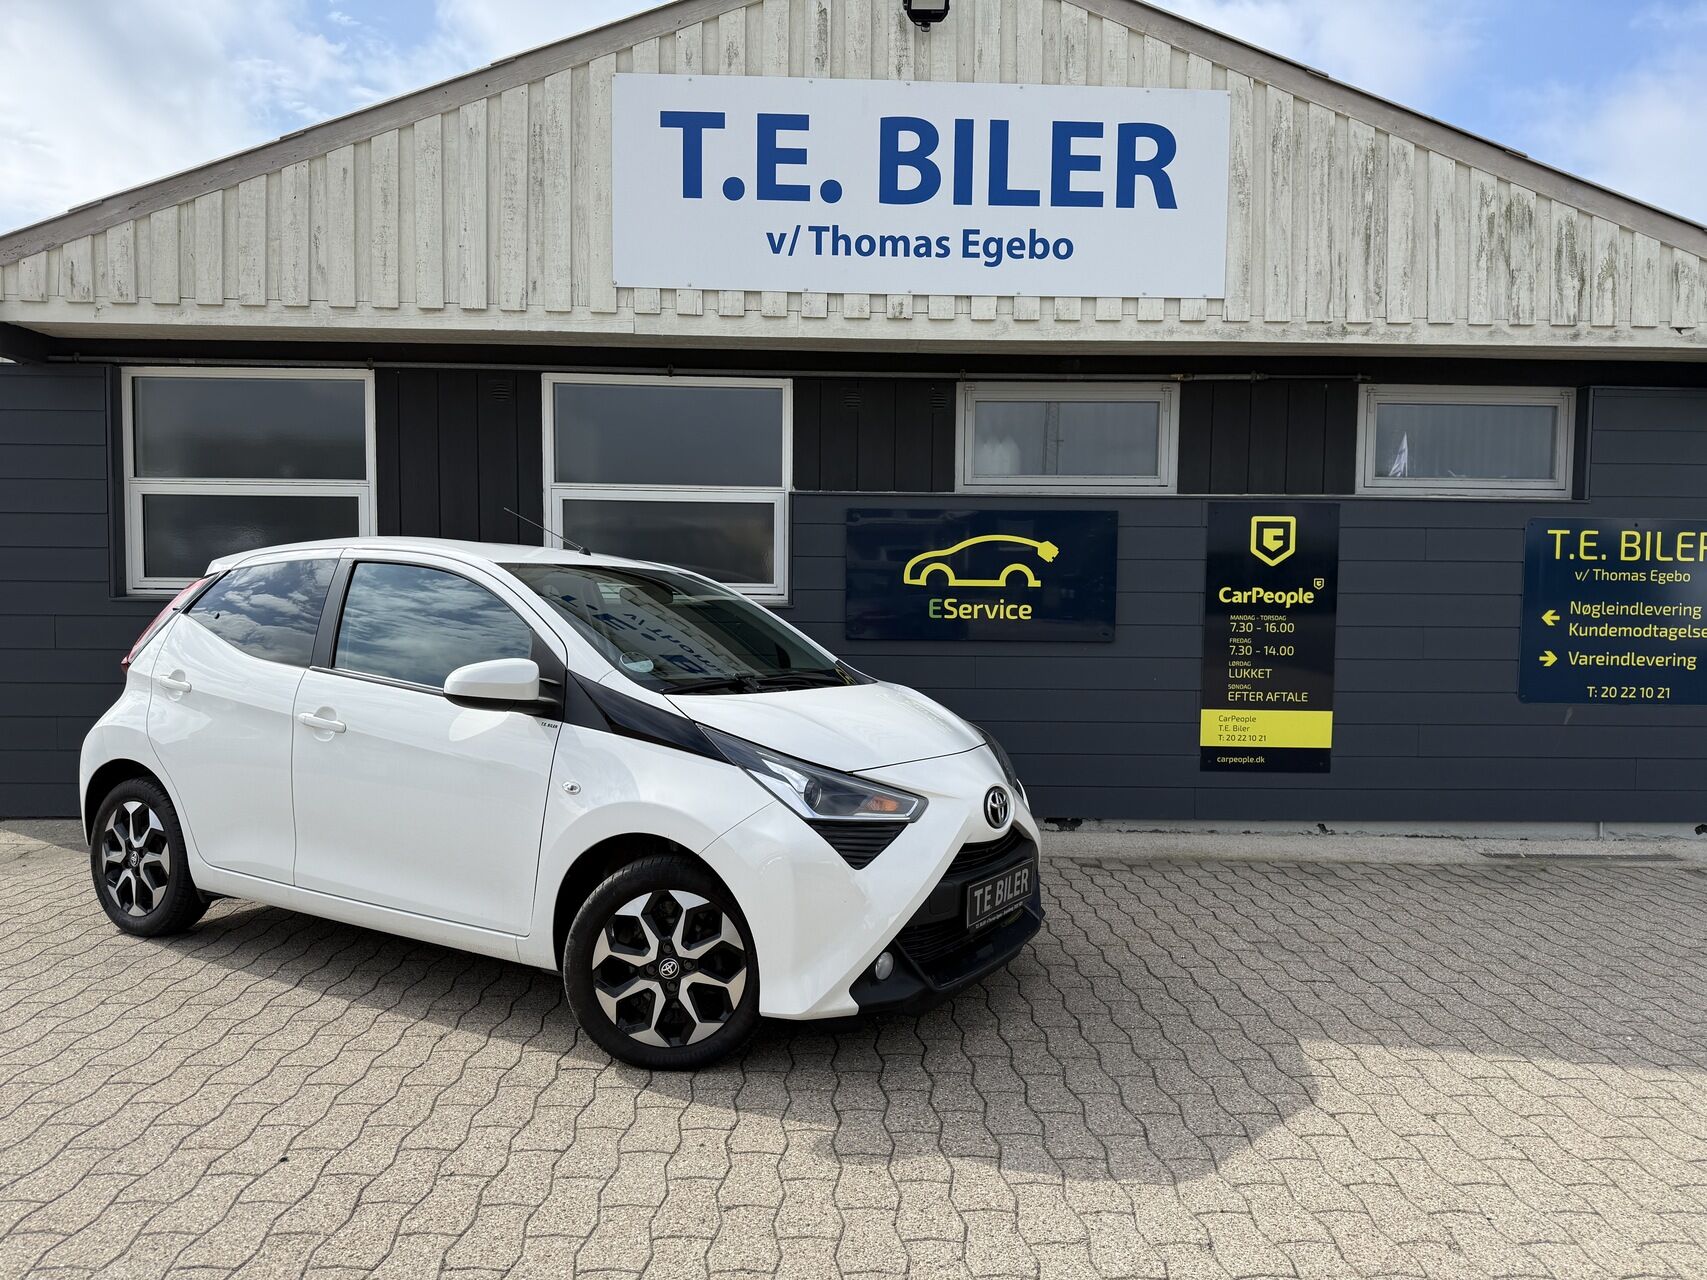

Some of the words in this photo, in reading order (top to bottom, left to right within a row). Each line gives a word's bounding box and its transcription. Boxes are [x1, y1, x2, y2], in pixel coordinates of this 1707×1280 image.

[660, 111, 842, 203] T.E.
[879, 117, 1177, 209] BILER
[766, 225, 801, 256] v/
[808, 225, 950, 258] Thomas
[962, 229, 1073, 267] Egebo
[1547, 529, 1607, 561] T.E.
[1574, 568, 1590, 582] v/
[1592, 568, 1647, 582] Thomas
[1650, 569, 1692, 585] Egebo
[1218, 586, 1315, 609] CarPeople
[929, 598, 1033, 620] EService
[1570, 600, 1703, 620] Nøgleindlevering
[1260, 614, 1287, 622] TORSDAG
[1229, 622, 1254, 633] 7.30
[1264, 622, 1295, 633] 16.00
[1229, 645, 1253, 656] 7.30
[1263, 645, 1295, 656] 14.00
[1568, 651, 1697, 671] Vareindlevering
[1228, 668, 1273, 679] LUKKET
[1227, 691, 1264, 702] EFTER
[1265, 691, 1309, 703] AFTALE
[1586, 686, 1598, 698] T:
[1600, 686, 1618, 698] 20
[1620, 686, 1637, 699] 22
[1639, 686, 1654, 699] 10
[1656, 687, 1670, 699] 21
[1218, 714, 1257, 724] CarPeople
[1232, 724, 1251, 733] Biler
[1225, 734, 1236, 742] 20
[1237, 734, 1247, 742] 22
[1248, 734, 1257, 742] 10
[1258, 734, 1267, 742] 21
[1216, 755, 1265, 765] carpeople.dk
[995, 867, 1030, 907] BILER
